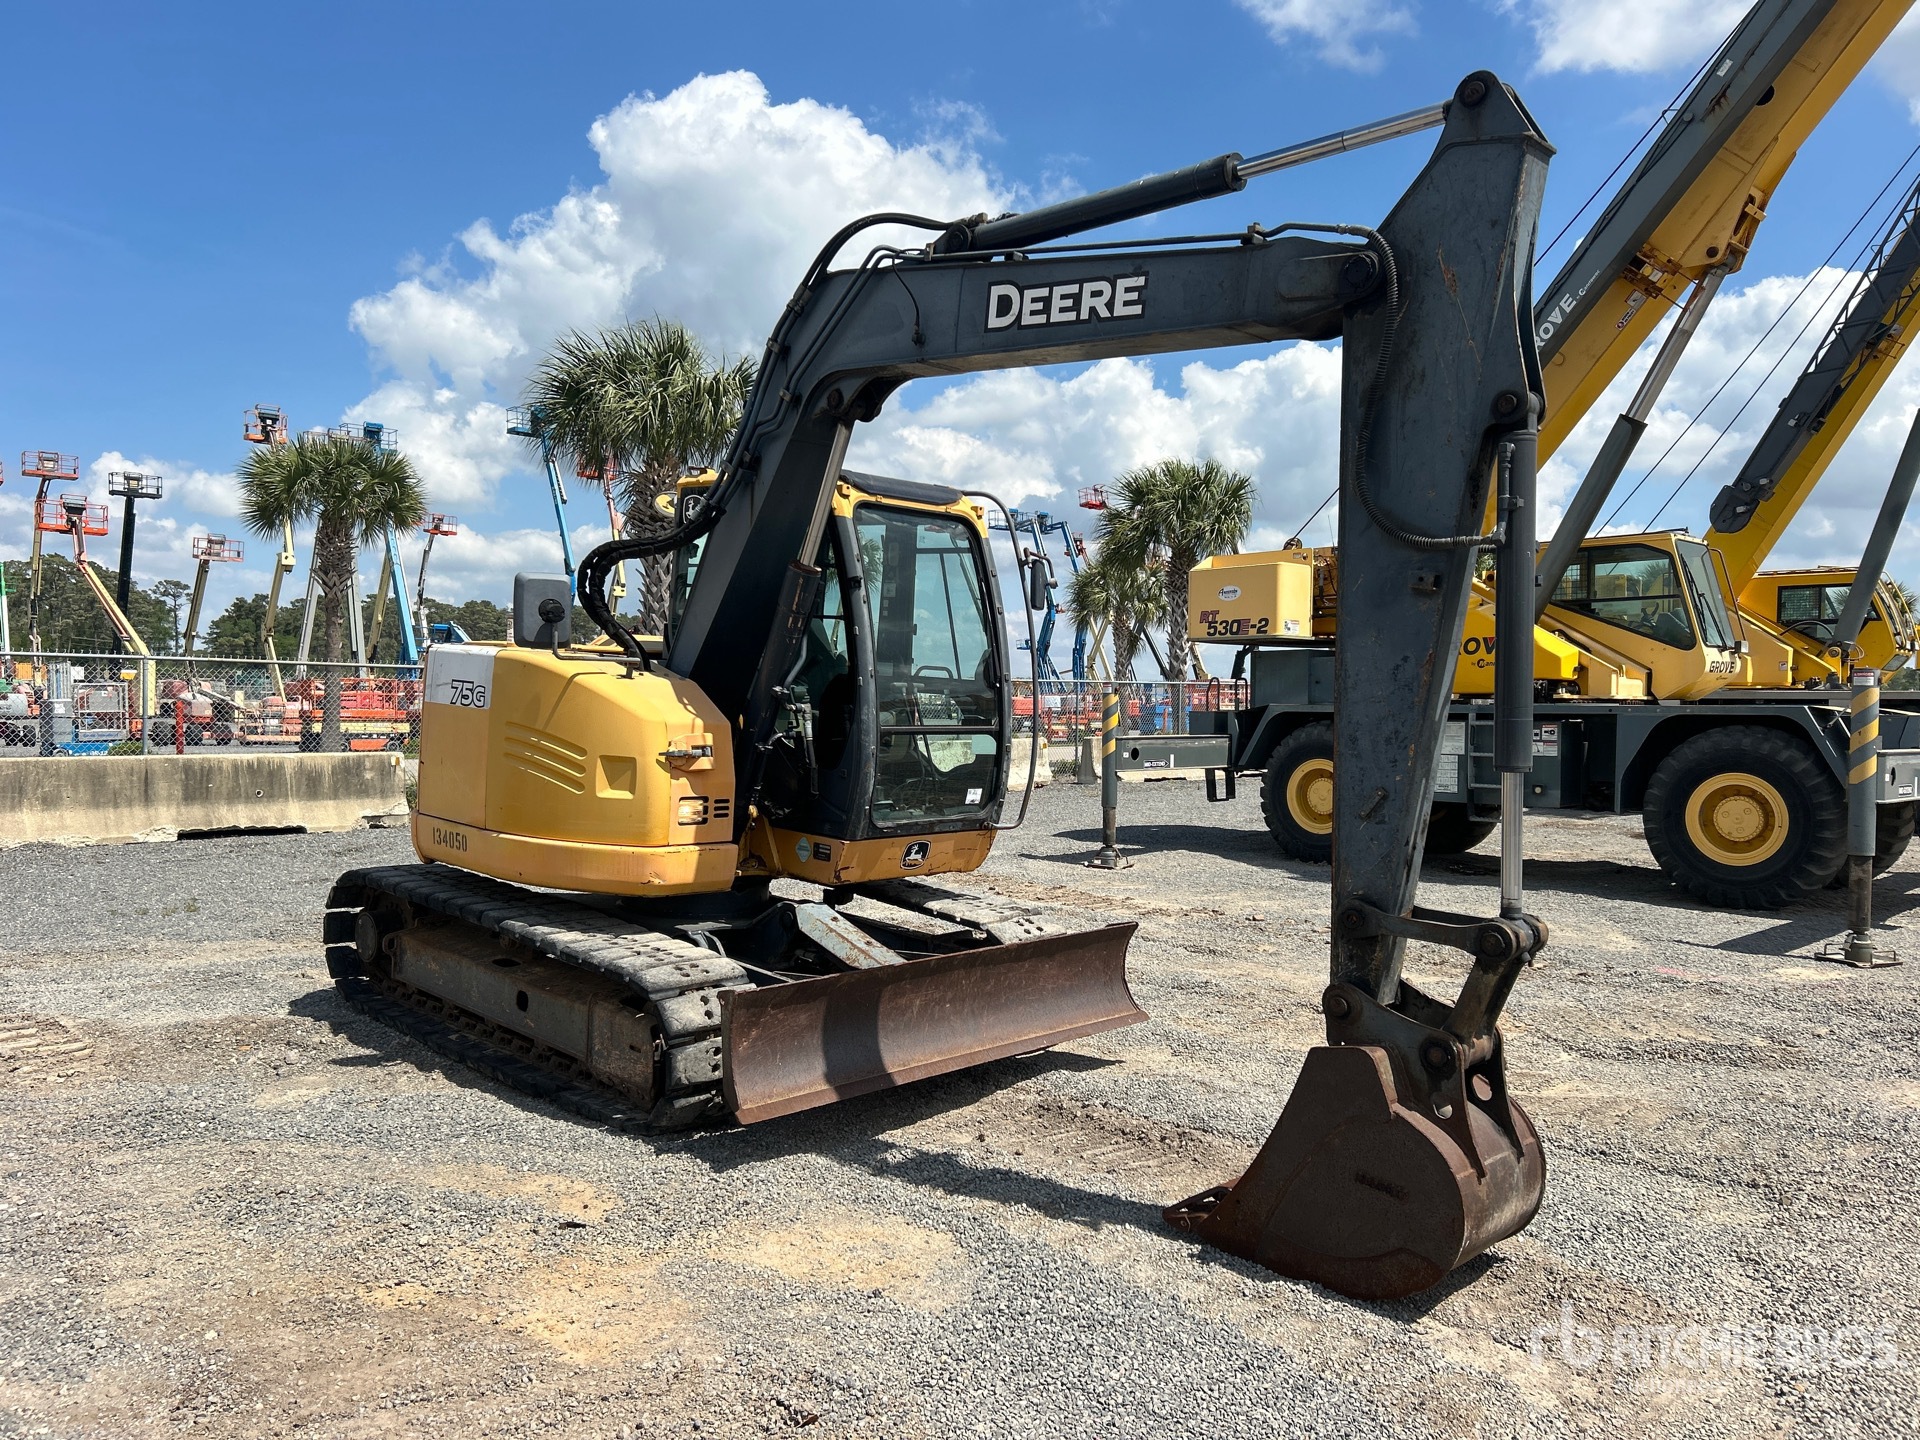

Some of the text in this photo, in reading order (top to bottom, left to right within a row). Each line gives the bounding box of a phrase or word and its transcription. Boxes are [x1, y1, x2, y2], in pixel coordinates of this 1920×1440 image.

[986, 272, 1148, 331] DEERE
[1535, 293, 1577, 351] ROVE
[1199, 609, 1220, 624] RT
[1206, 617, 1270, 637] 530E-2
[1709, 660, 1735, 674] GROVE
[450, 679, 486, 708] 75G
[432, 826, 468, 852] 134050
